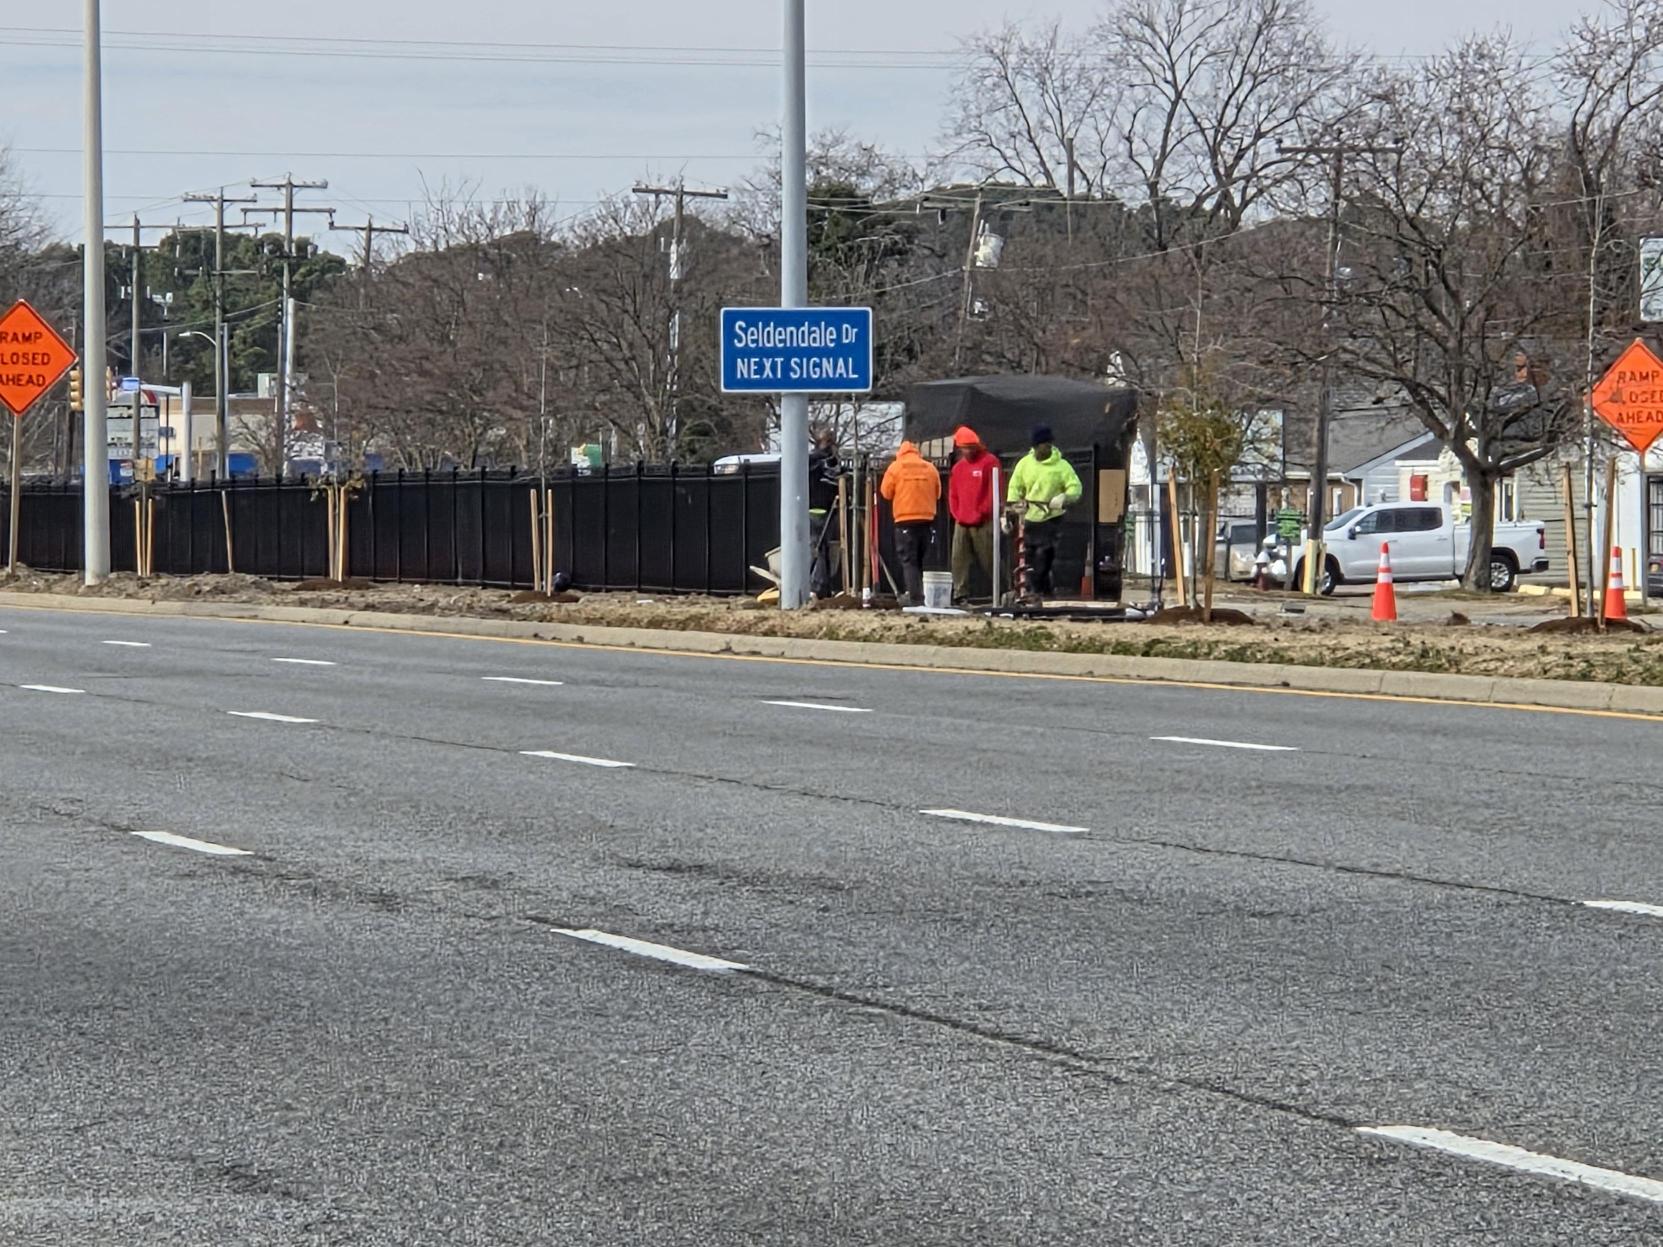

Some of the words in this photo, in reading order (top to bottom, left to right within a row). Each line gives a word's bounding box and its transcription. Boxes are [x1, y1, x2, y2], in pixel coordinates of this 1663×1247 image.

[0, 331, 43, 344] RAMP
[734, 320, 837, 348] Seldendale
[842, 323, 859, 344] Dr
[0, 352, 51, 366] LOSED
[736, 357, 784, 379] NEXT
[789, 357, 859, 379] SIGNAL
[1617, 370, 1660, 384] RAMP
[1616, 410, 1663, 424] AHEAD
